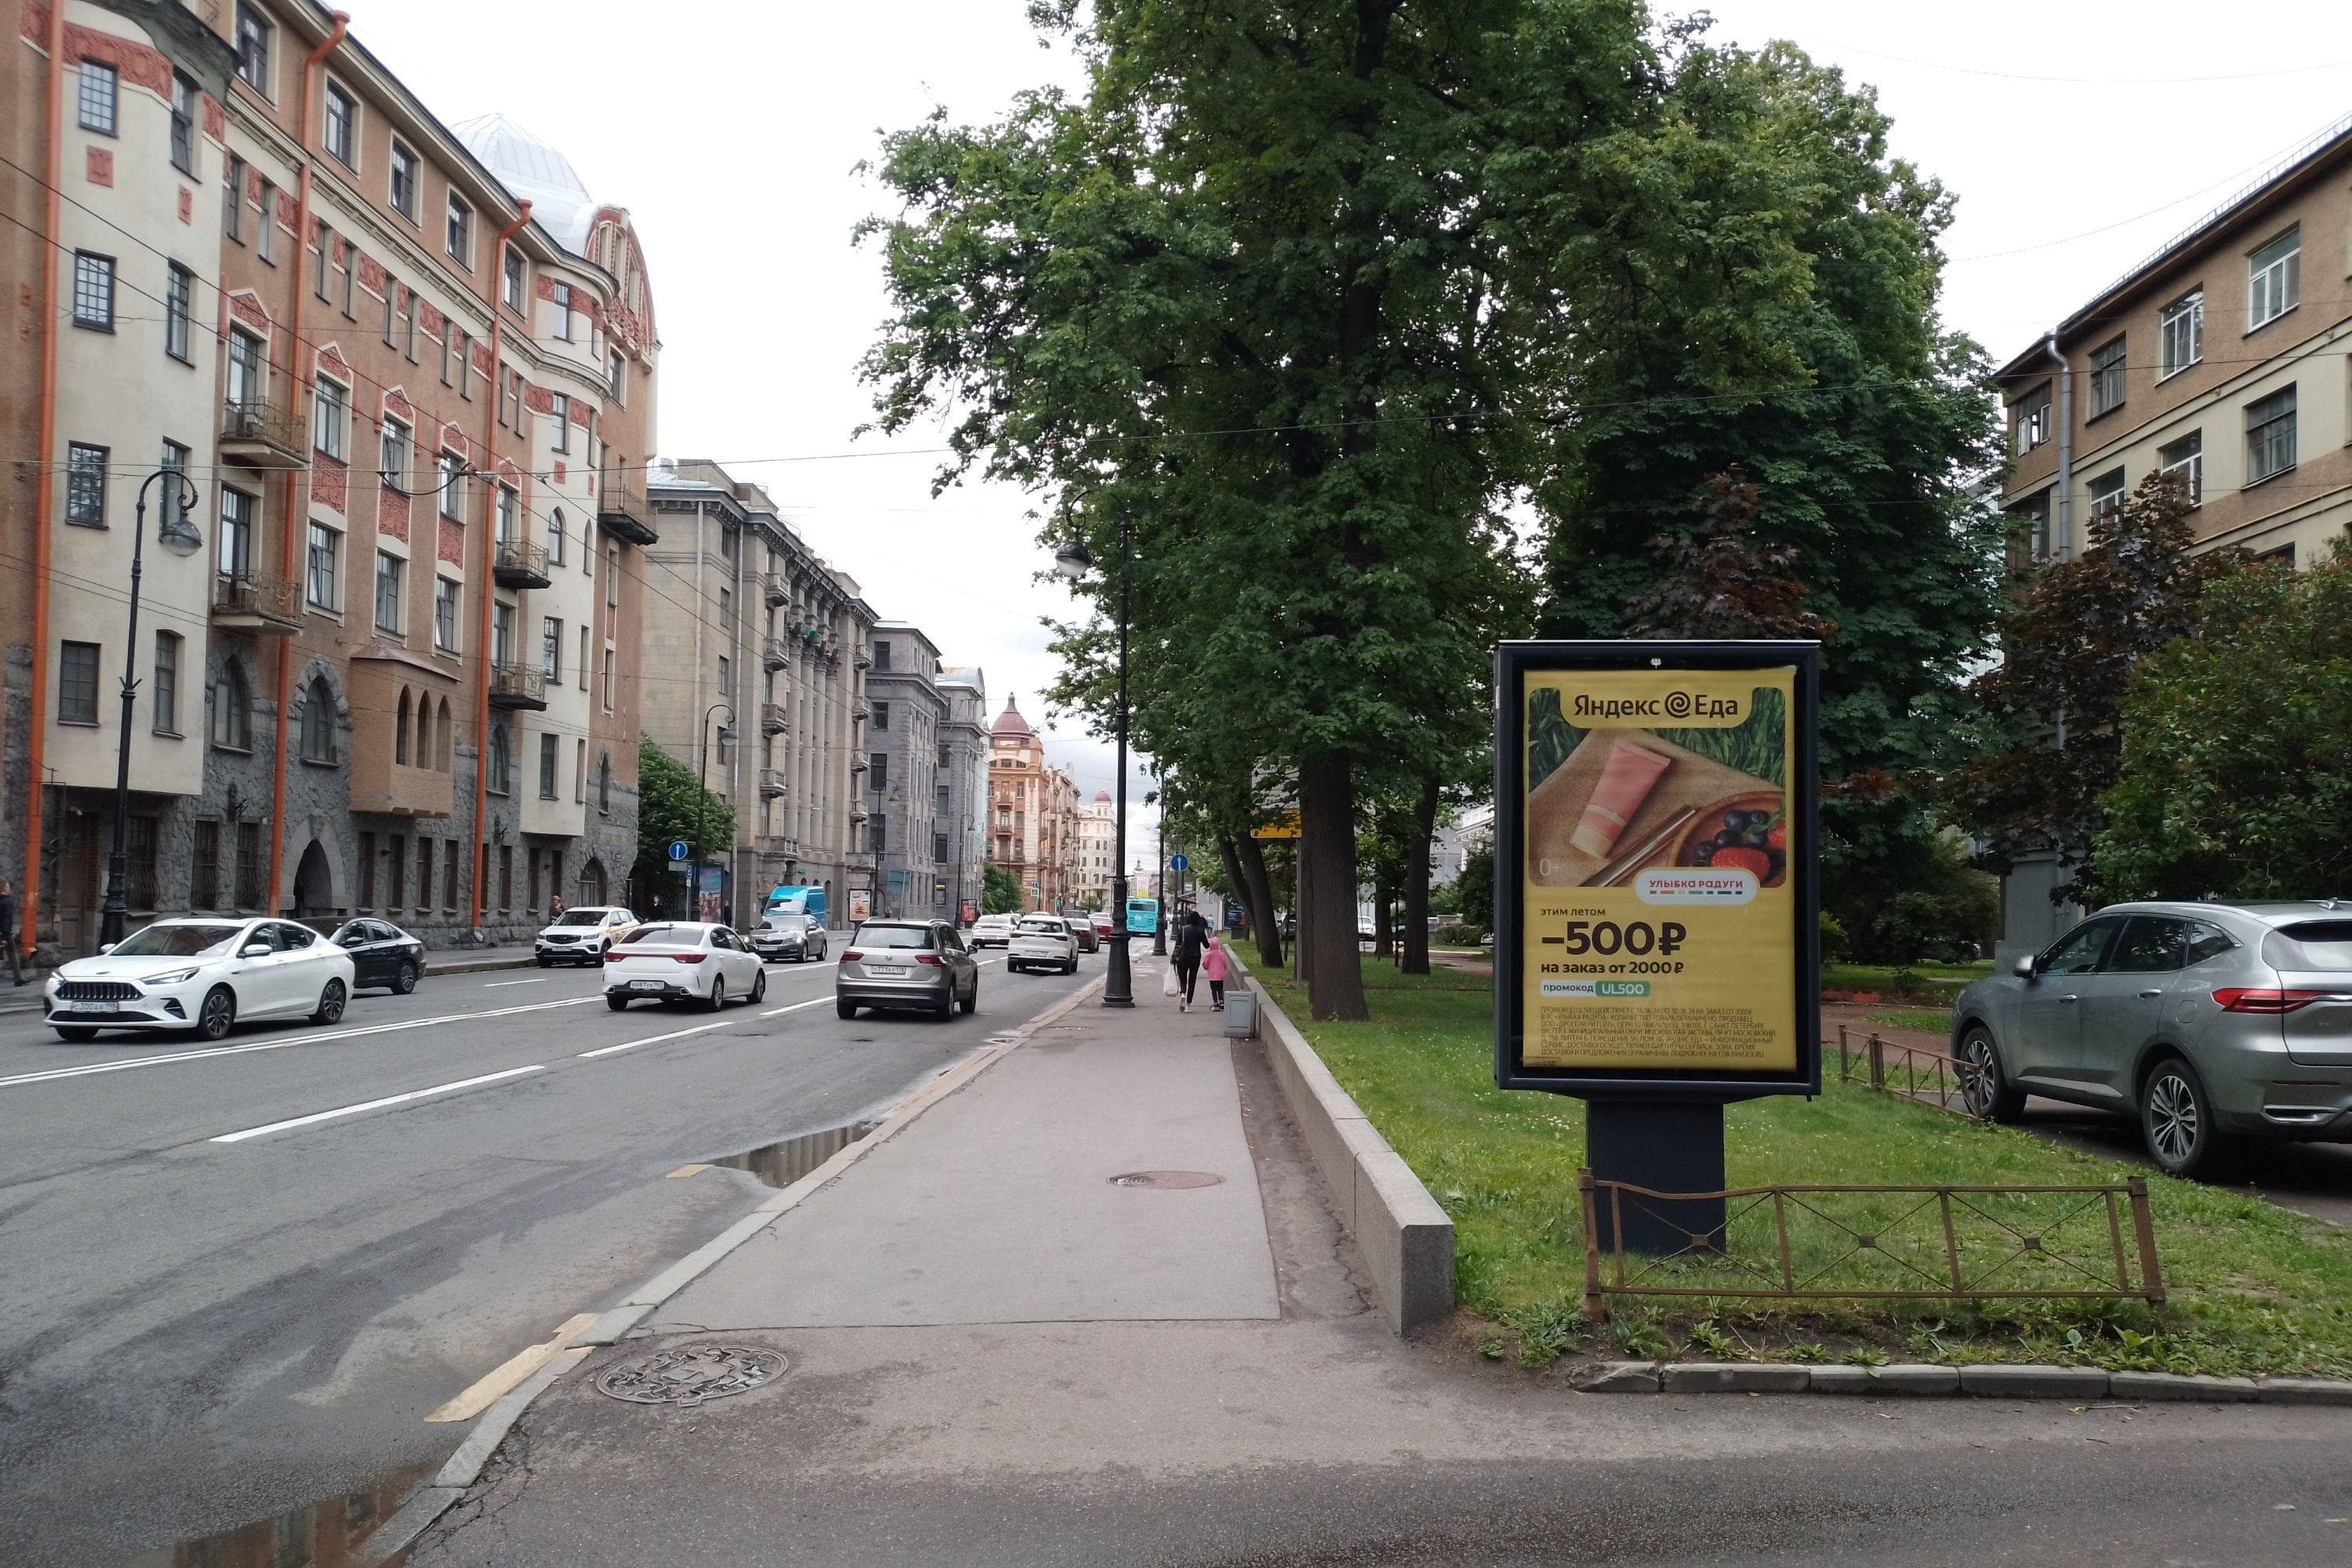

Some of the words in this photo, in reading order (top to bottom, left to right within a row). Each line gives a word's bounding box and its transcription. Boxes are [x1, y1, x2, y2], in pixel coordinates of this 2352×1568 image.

[1574, 695, 1660, 718] Яндекс
[1695, 695, 1738, 718] Еда
[1541, 907, 1568, 916] этим
[1570, 907, 1606, 916] летом
[1541, 964, 1559, 973] на
[1563, 964, 1606, 974] заказ
[1609, 964, 1626, 974] от
[1543, 984, 1594, 993] промокод
[1602, 983, 1645, 995] UL500
